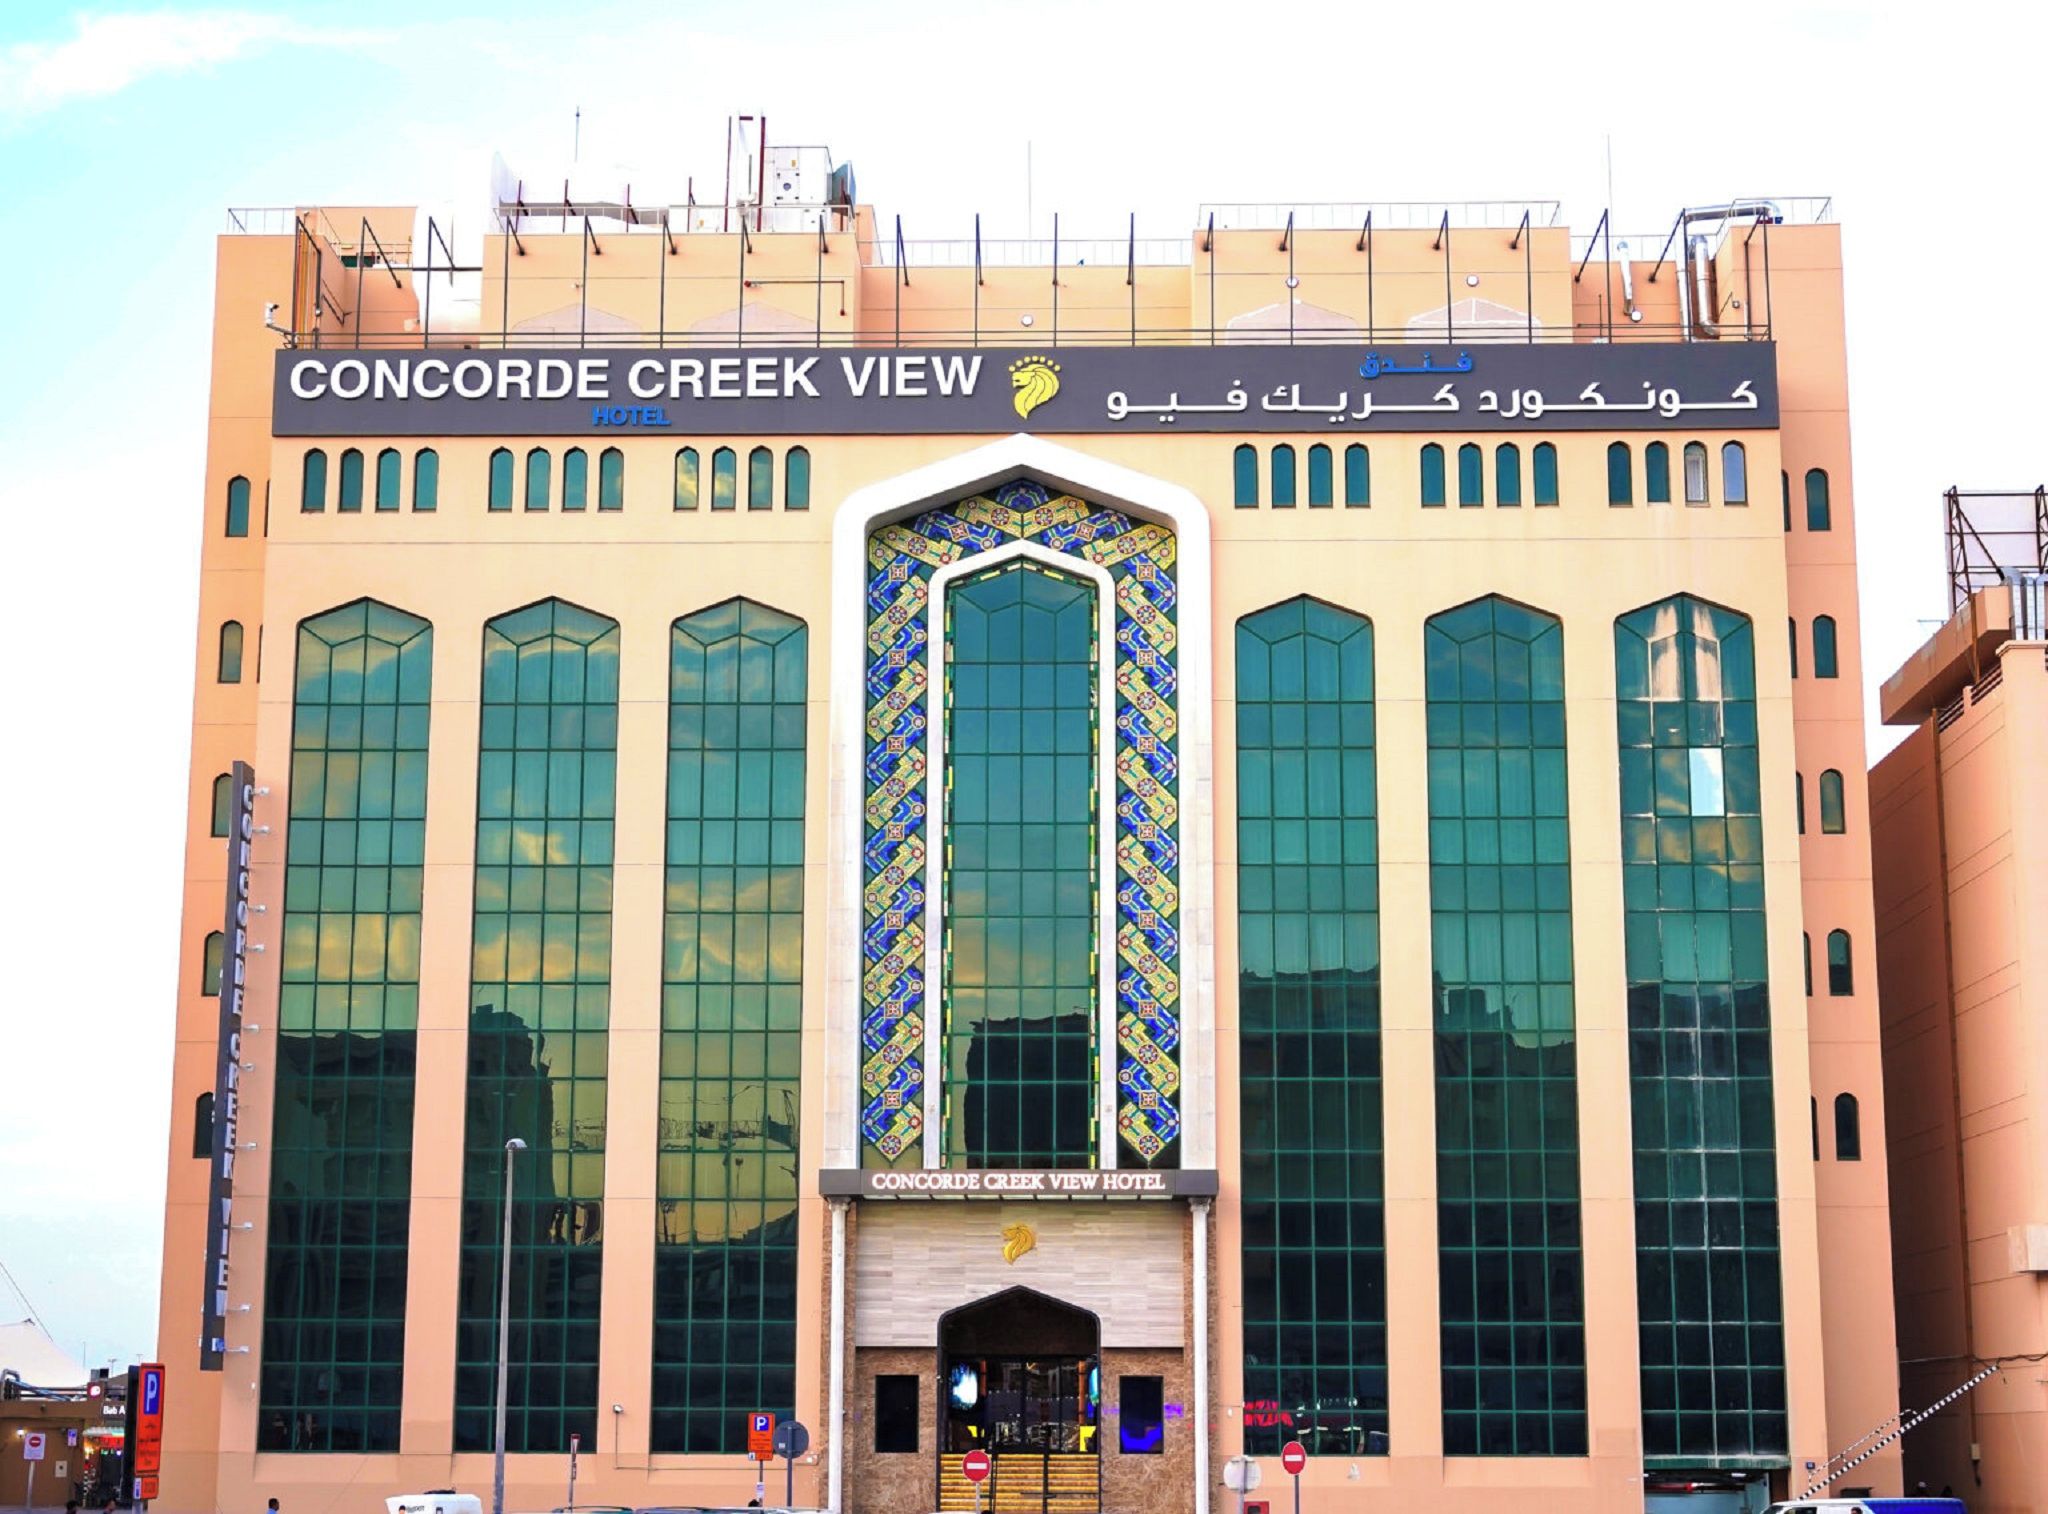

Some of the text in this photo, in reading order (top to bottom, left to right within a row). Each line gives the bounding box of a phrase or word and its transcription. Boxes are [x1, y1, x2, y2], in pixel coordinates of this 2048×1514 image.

[289, 355, 984, 399] CONCORDE CREEK VIEW
[1359, 351, 1474, 379] فندق
[591, 404, 673, 427] HOTEL
[1106, 379, 1759, 423] كونكورد كريك فيو
[232, 783, 253, 1016] CONCORDE
[871, 1173, 1166, 1190] CONCORDE CREEK VIEW HOTEL
[147, 1373, 157, 1412] P
[756, 1416, 767, 1430] P
